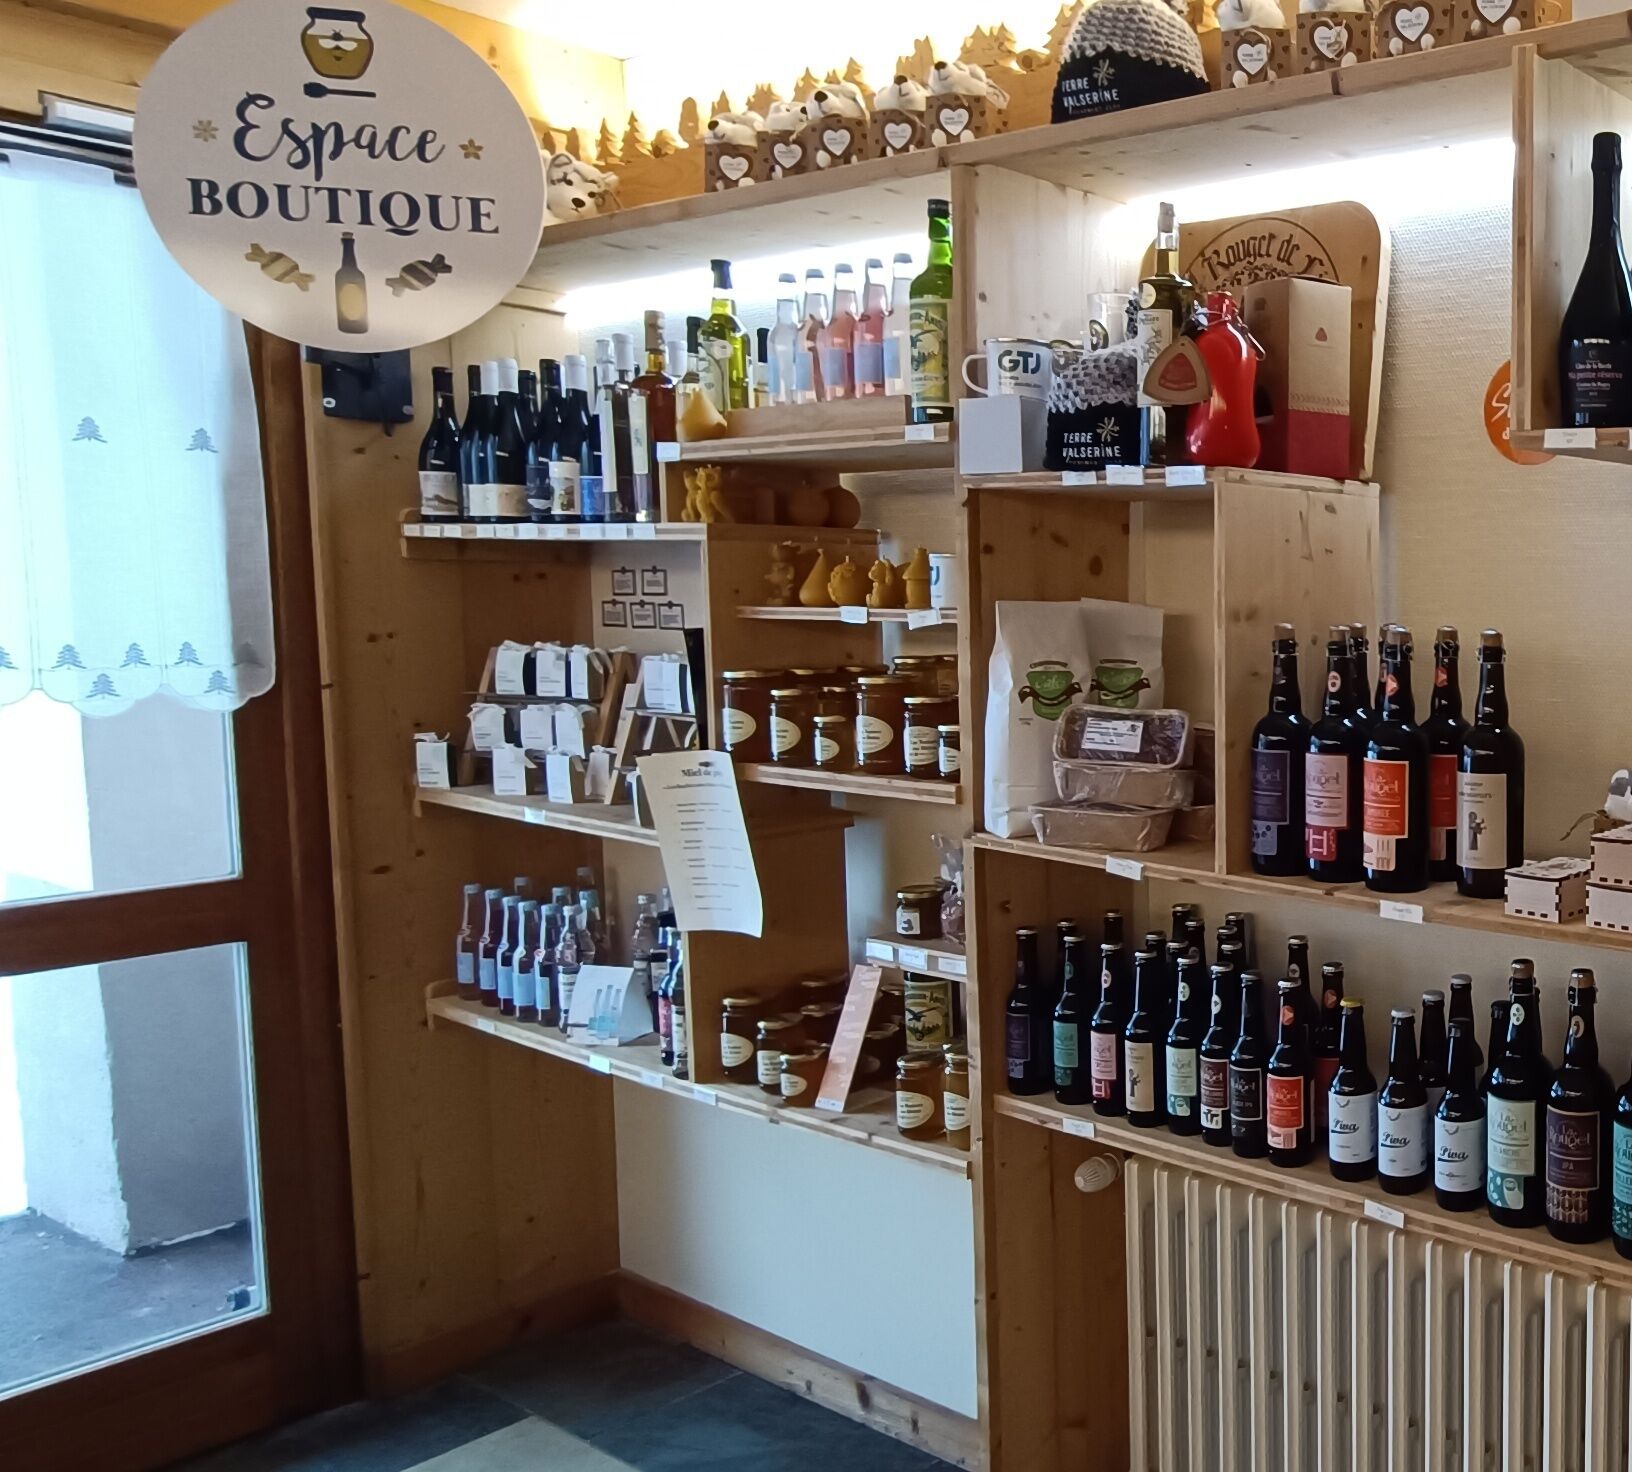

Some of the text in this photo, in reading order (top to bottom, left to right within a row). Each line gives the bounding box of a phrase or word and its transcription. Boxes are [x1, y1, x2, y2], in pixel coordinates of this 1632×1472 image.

[1062, 77, 1089, 92] TERRE
[1063, 88, 1120, 114] VALSERINE
[232, 91, 446, 181] Espace
[186, 177, 499, 236] BOUTIQUE
[1277, 233, 1300, 267] de
[998, 350, 1041, 375] GTJ
[1064, 432, 1093, 444] TERRE
[1062, 443, 1122, 463] VALSERINE
